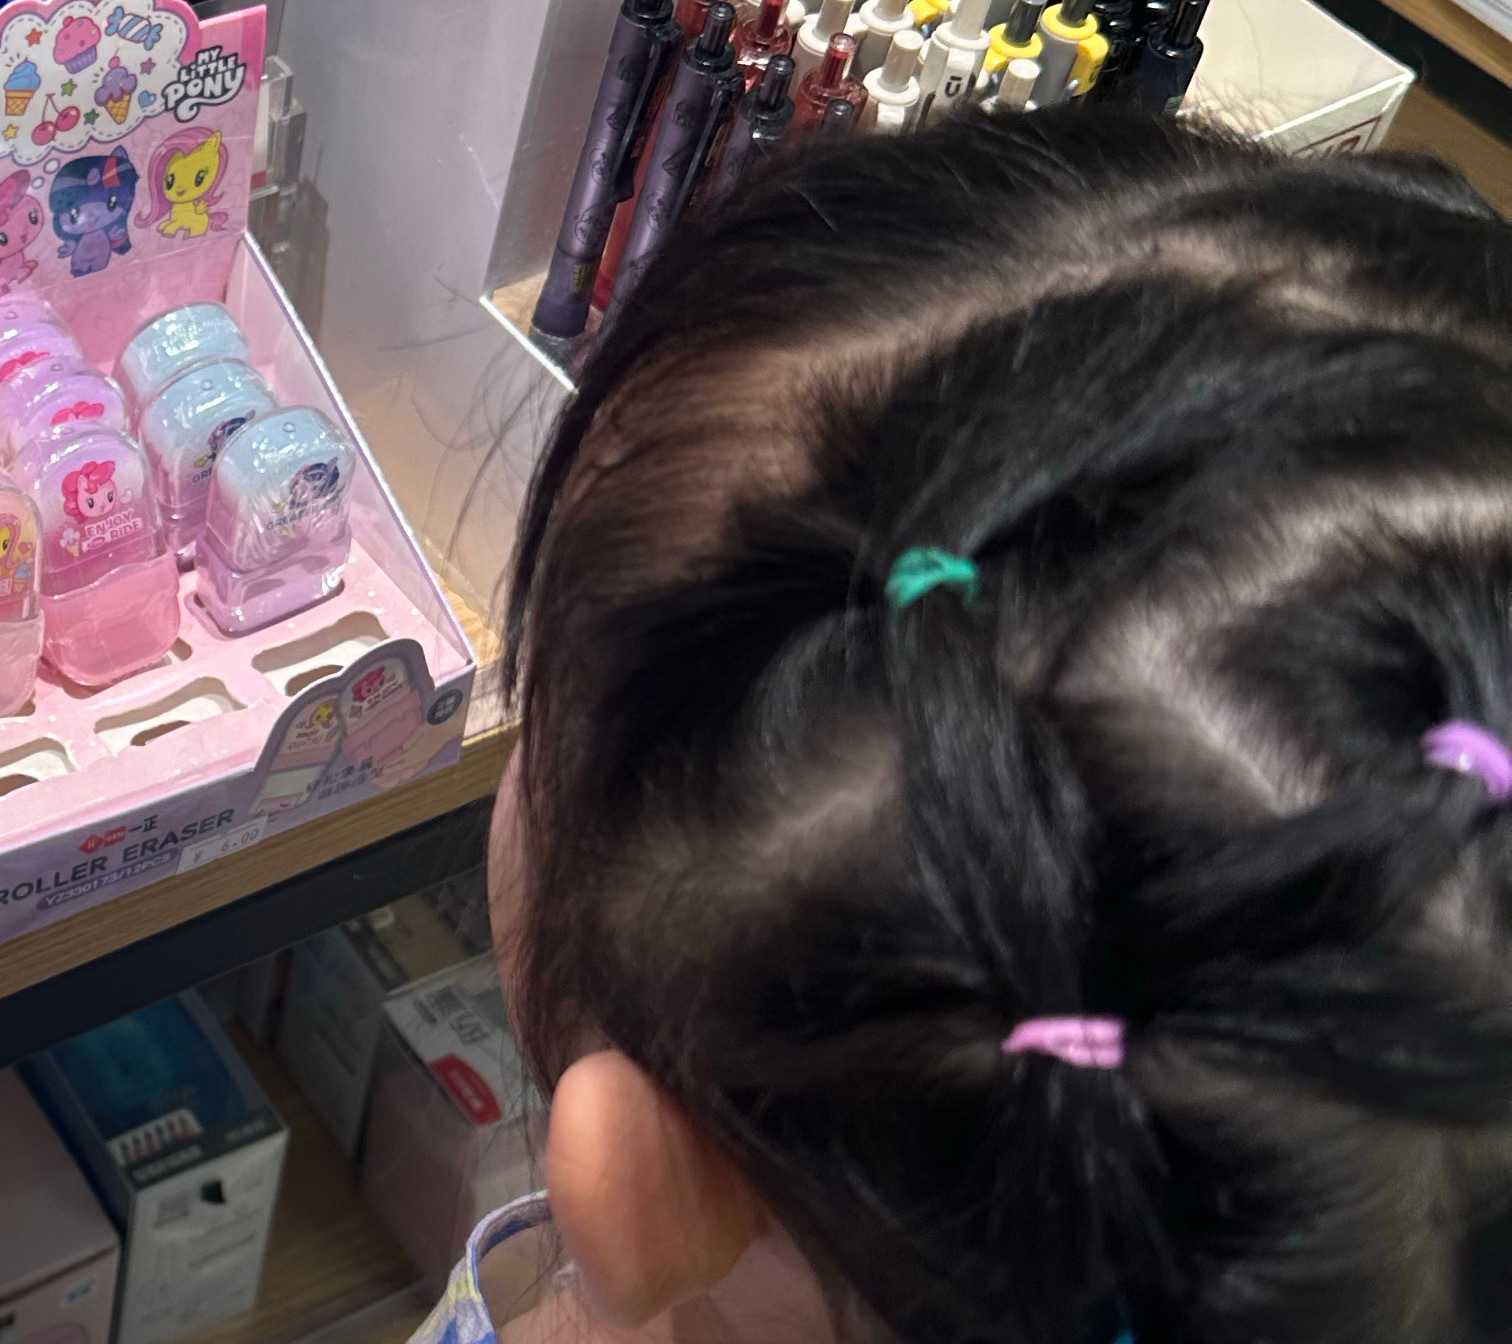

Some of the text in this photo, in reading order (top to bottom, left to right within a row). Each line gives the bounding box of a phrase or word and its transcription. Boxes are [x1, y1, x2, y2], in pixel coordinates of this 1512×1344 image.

[196, 46, 223, 65] MY
[162, 64, 246, 123] PONY
[121, 808, 236, 864] ERASER
[128, 813, 159, 835] 一正
[219, 828, 260, 854] 6.00
